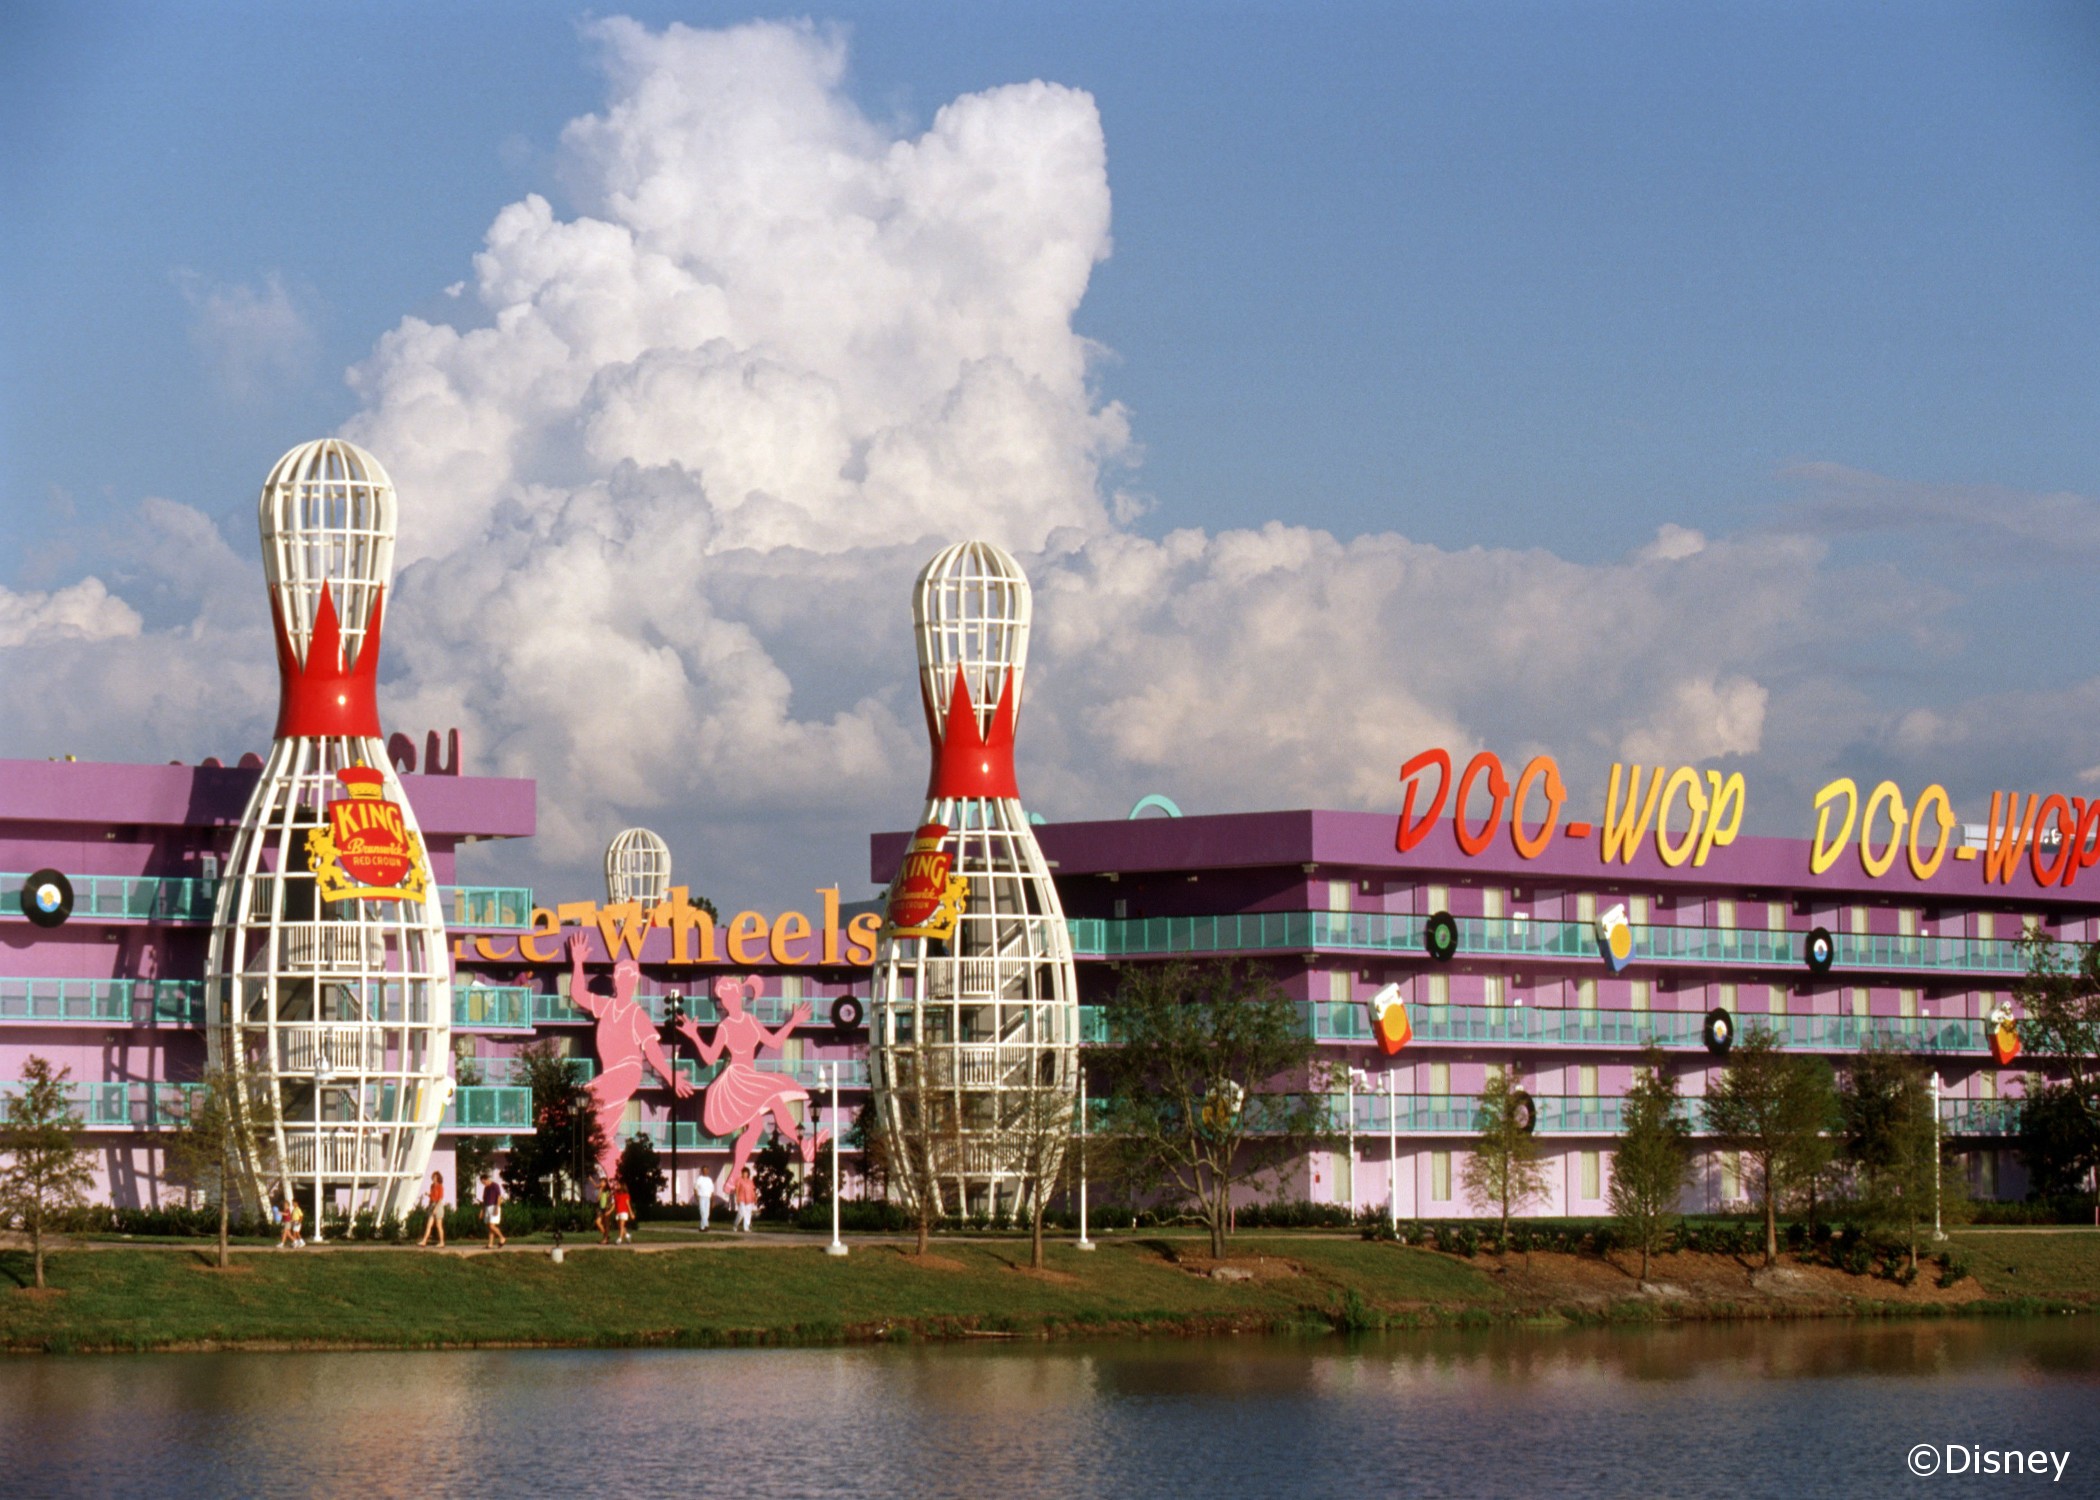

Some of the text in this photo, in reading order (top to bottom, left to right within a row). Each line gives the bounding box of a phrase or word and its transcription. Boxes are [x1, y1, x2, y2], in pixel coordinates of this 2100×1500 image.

[335, 803, 403, 844] KING
[1396, 748, 1745, 868] DOO-WOP
[353, 856, 402, 867] RED CROWN
[594, 884, 882, 966] wheels
